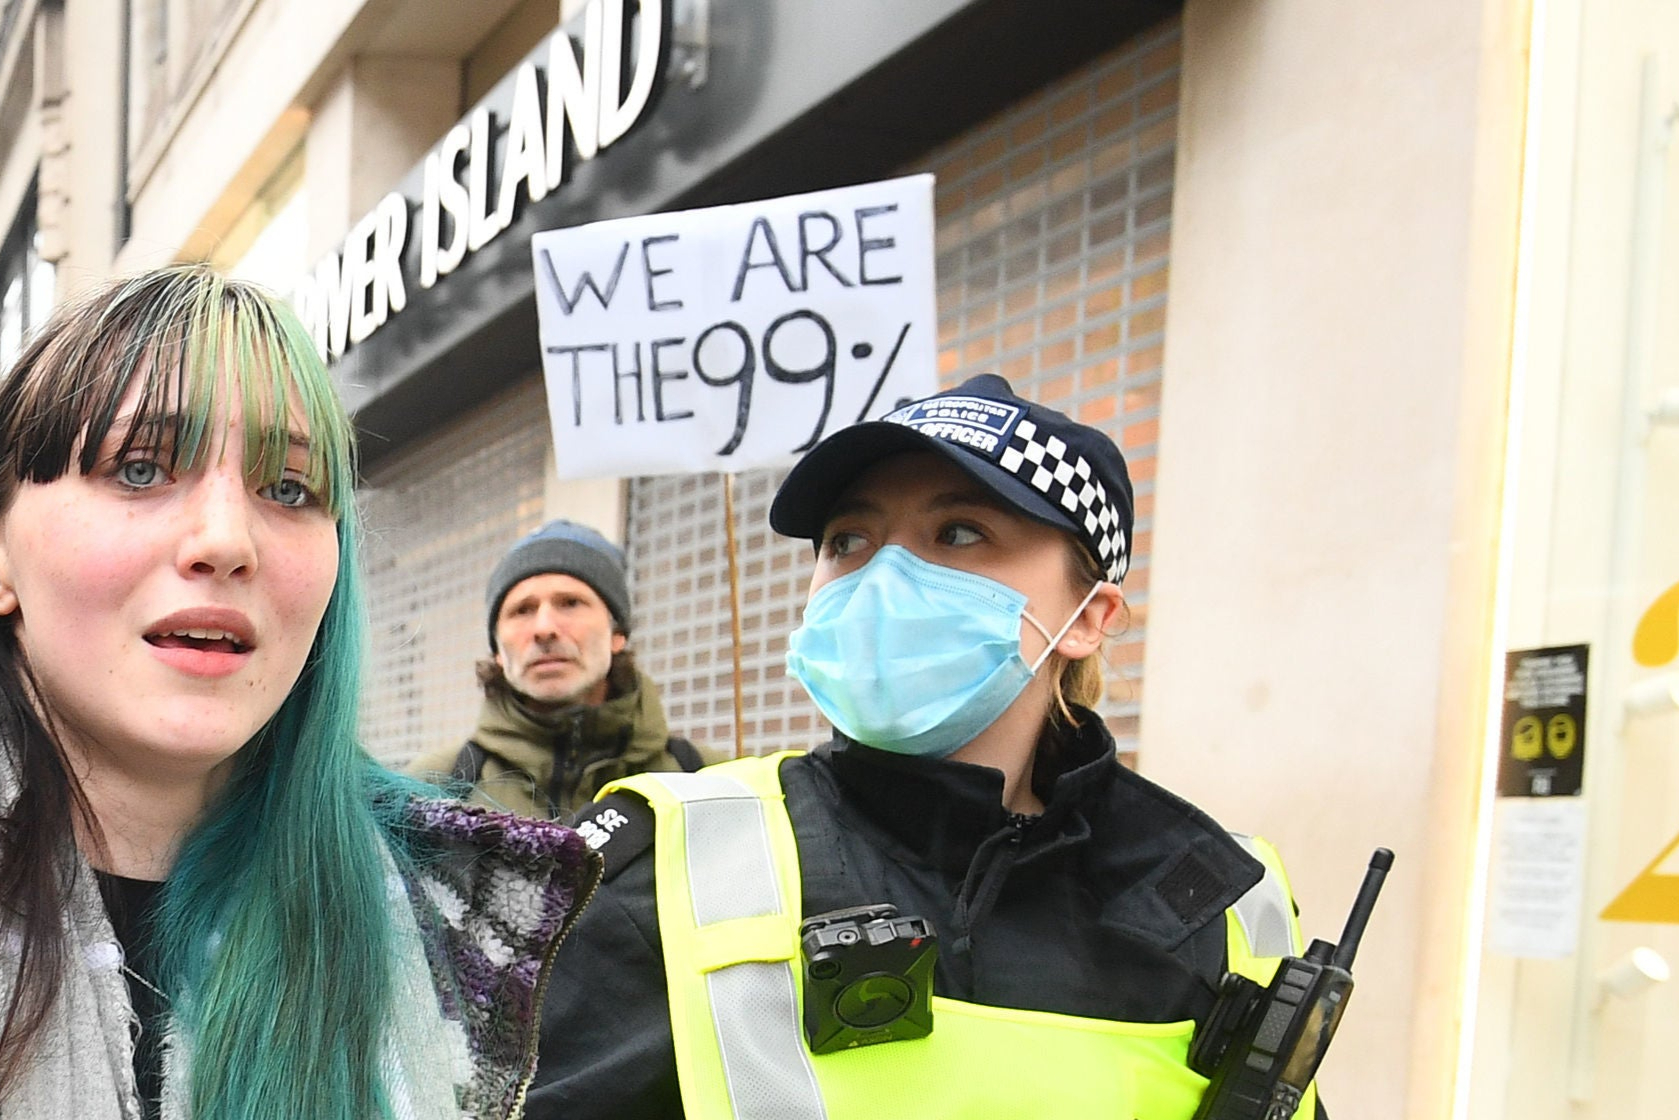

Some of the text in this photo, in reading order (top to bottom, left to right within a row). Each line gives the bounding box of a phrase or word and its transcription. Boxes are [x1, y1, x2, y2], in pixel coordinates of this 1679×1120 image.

[421, 0, 663, 288] ISLAND
[541, 203, 904, 316] WE ARE
[547, 308, 913, 456] THE 99%
[919, 422, 999, 453] OFFICER
[926, 408, 990, 424] POLICE
